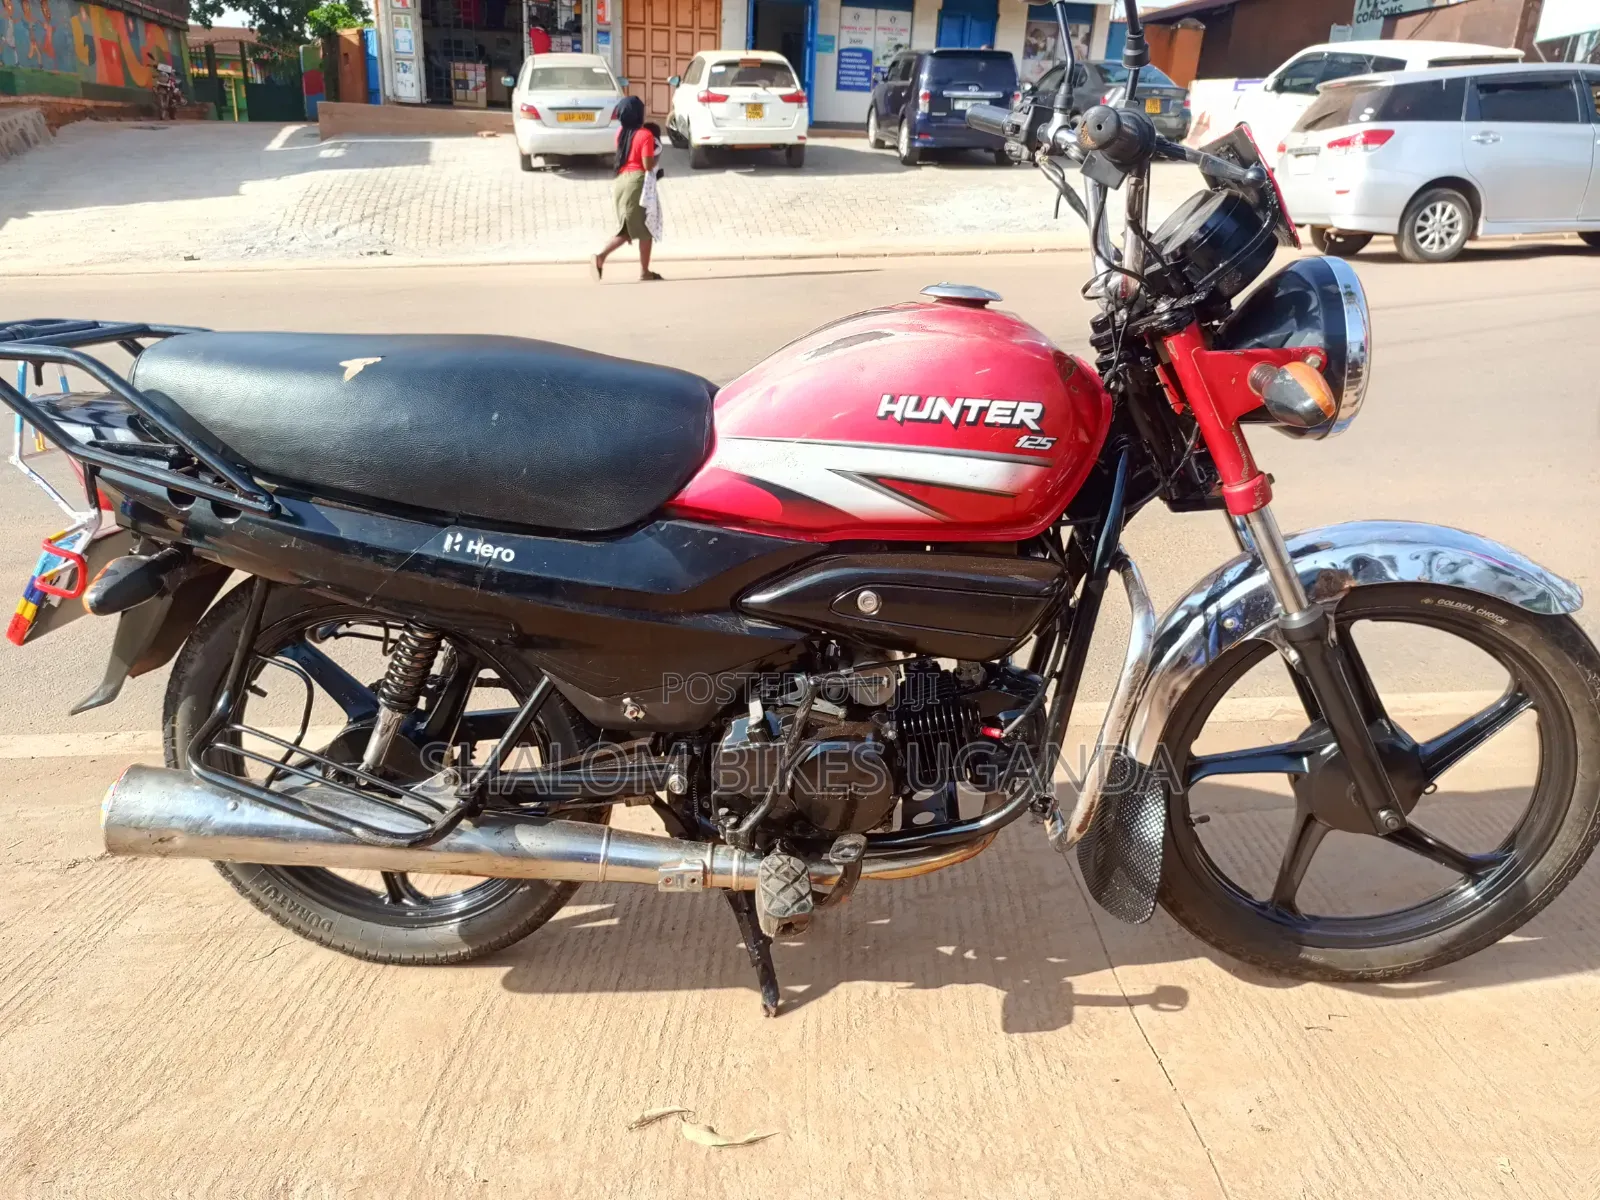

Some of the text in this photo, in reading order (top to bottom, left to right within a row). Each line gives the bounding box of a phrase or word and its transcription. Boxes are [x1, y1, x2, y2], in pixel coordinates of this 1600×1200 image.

[876, 394, 1046, 434] HUNTER
[1014, 435, 1058, 451] 125
[465, 540, 516, 563] Hero
[1437, 598, 1509, 625] GOLDEN CHOICE
